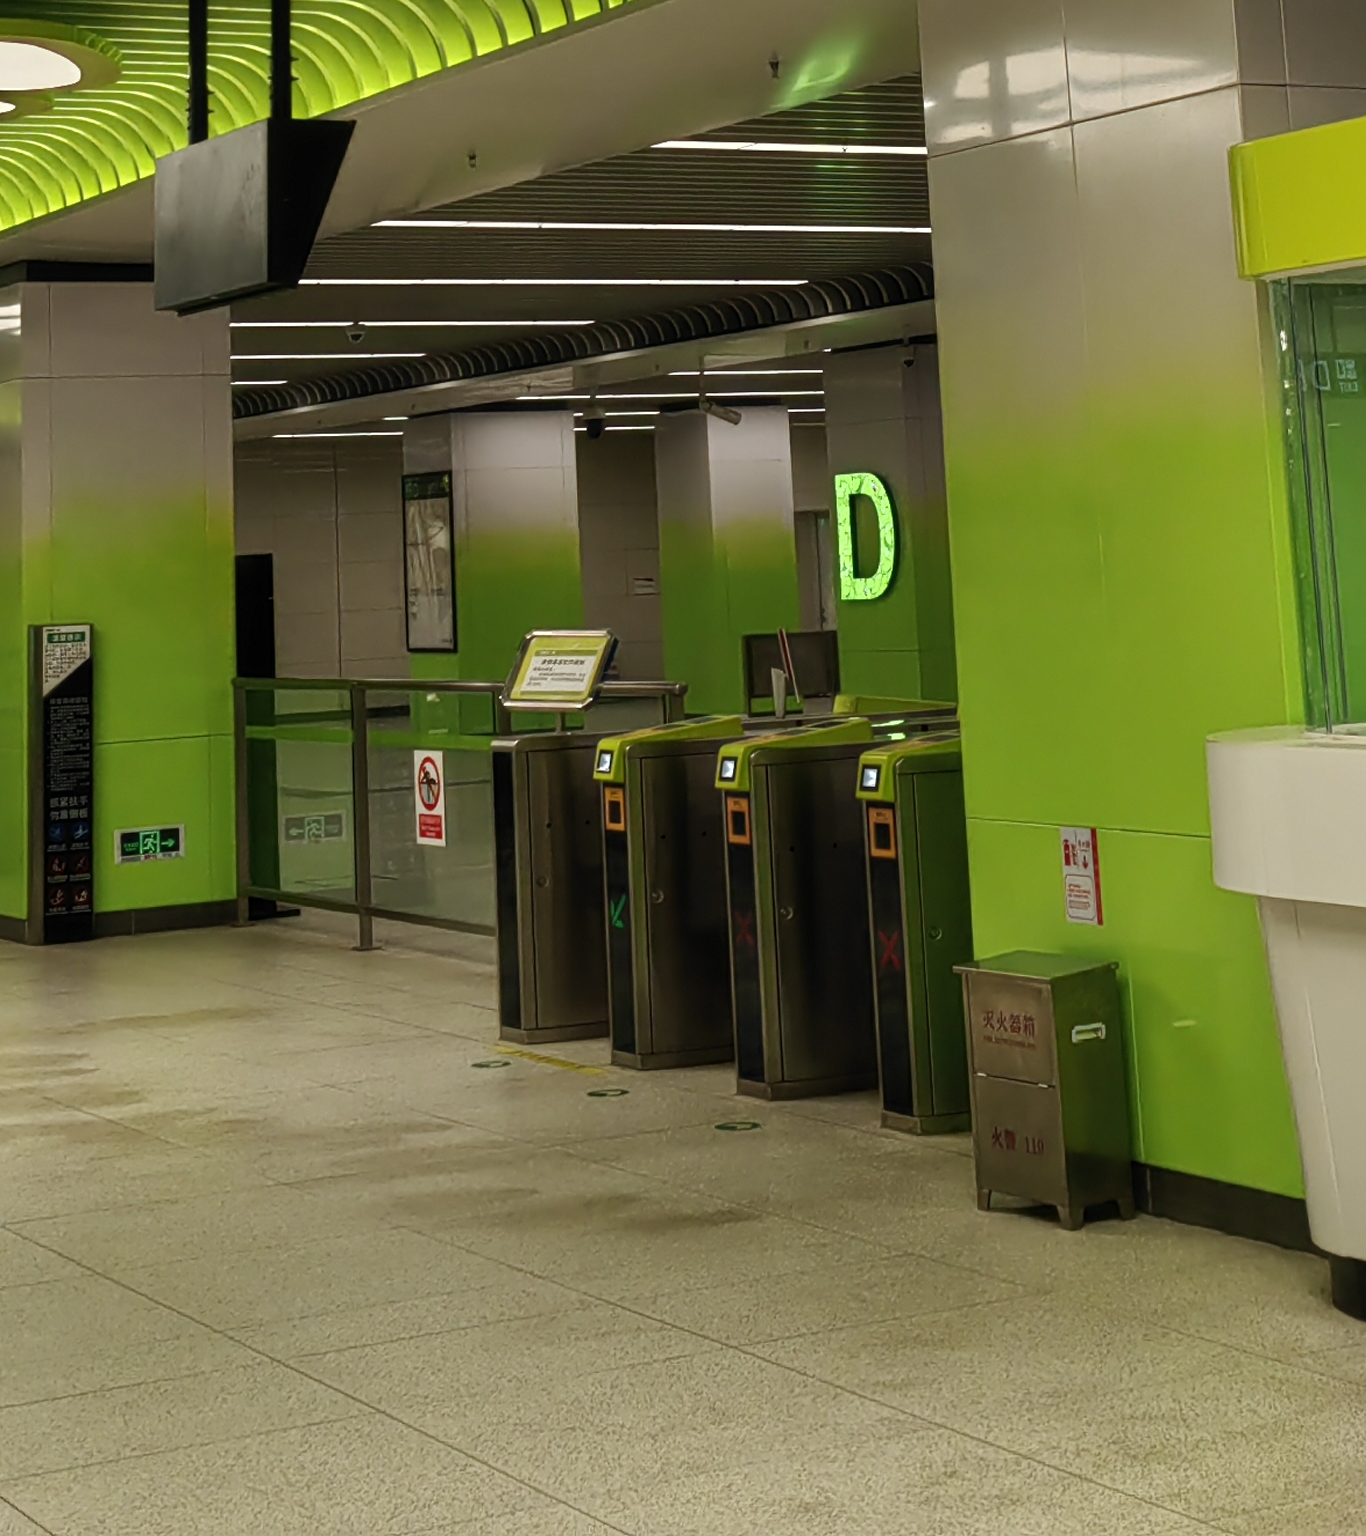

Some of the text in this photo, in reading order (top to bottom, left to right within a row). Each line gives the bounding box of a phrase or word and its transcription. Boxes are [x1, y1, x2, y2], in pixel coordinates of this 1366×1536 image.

[835, 472, 896, 601] D
[983, 1010, 1036, 1037] 灭火器箱
